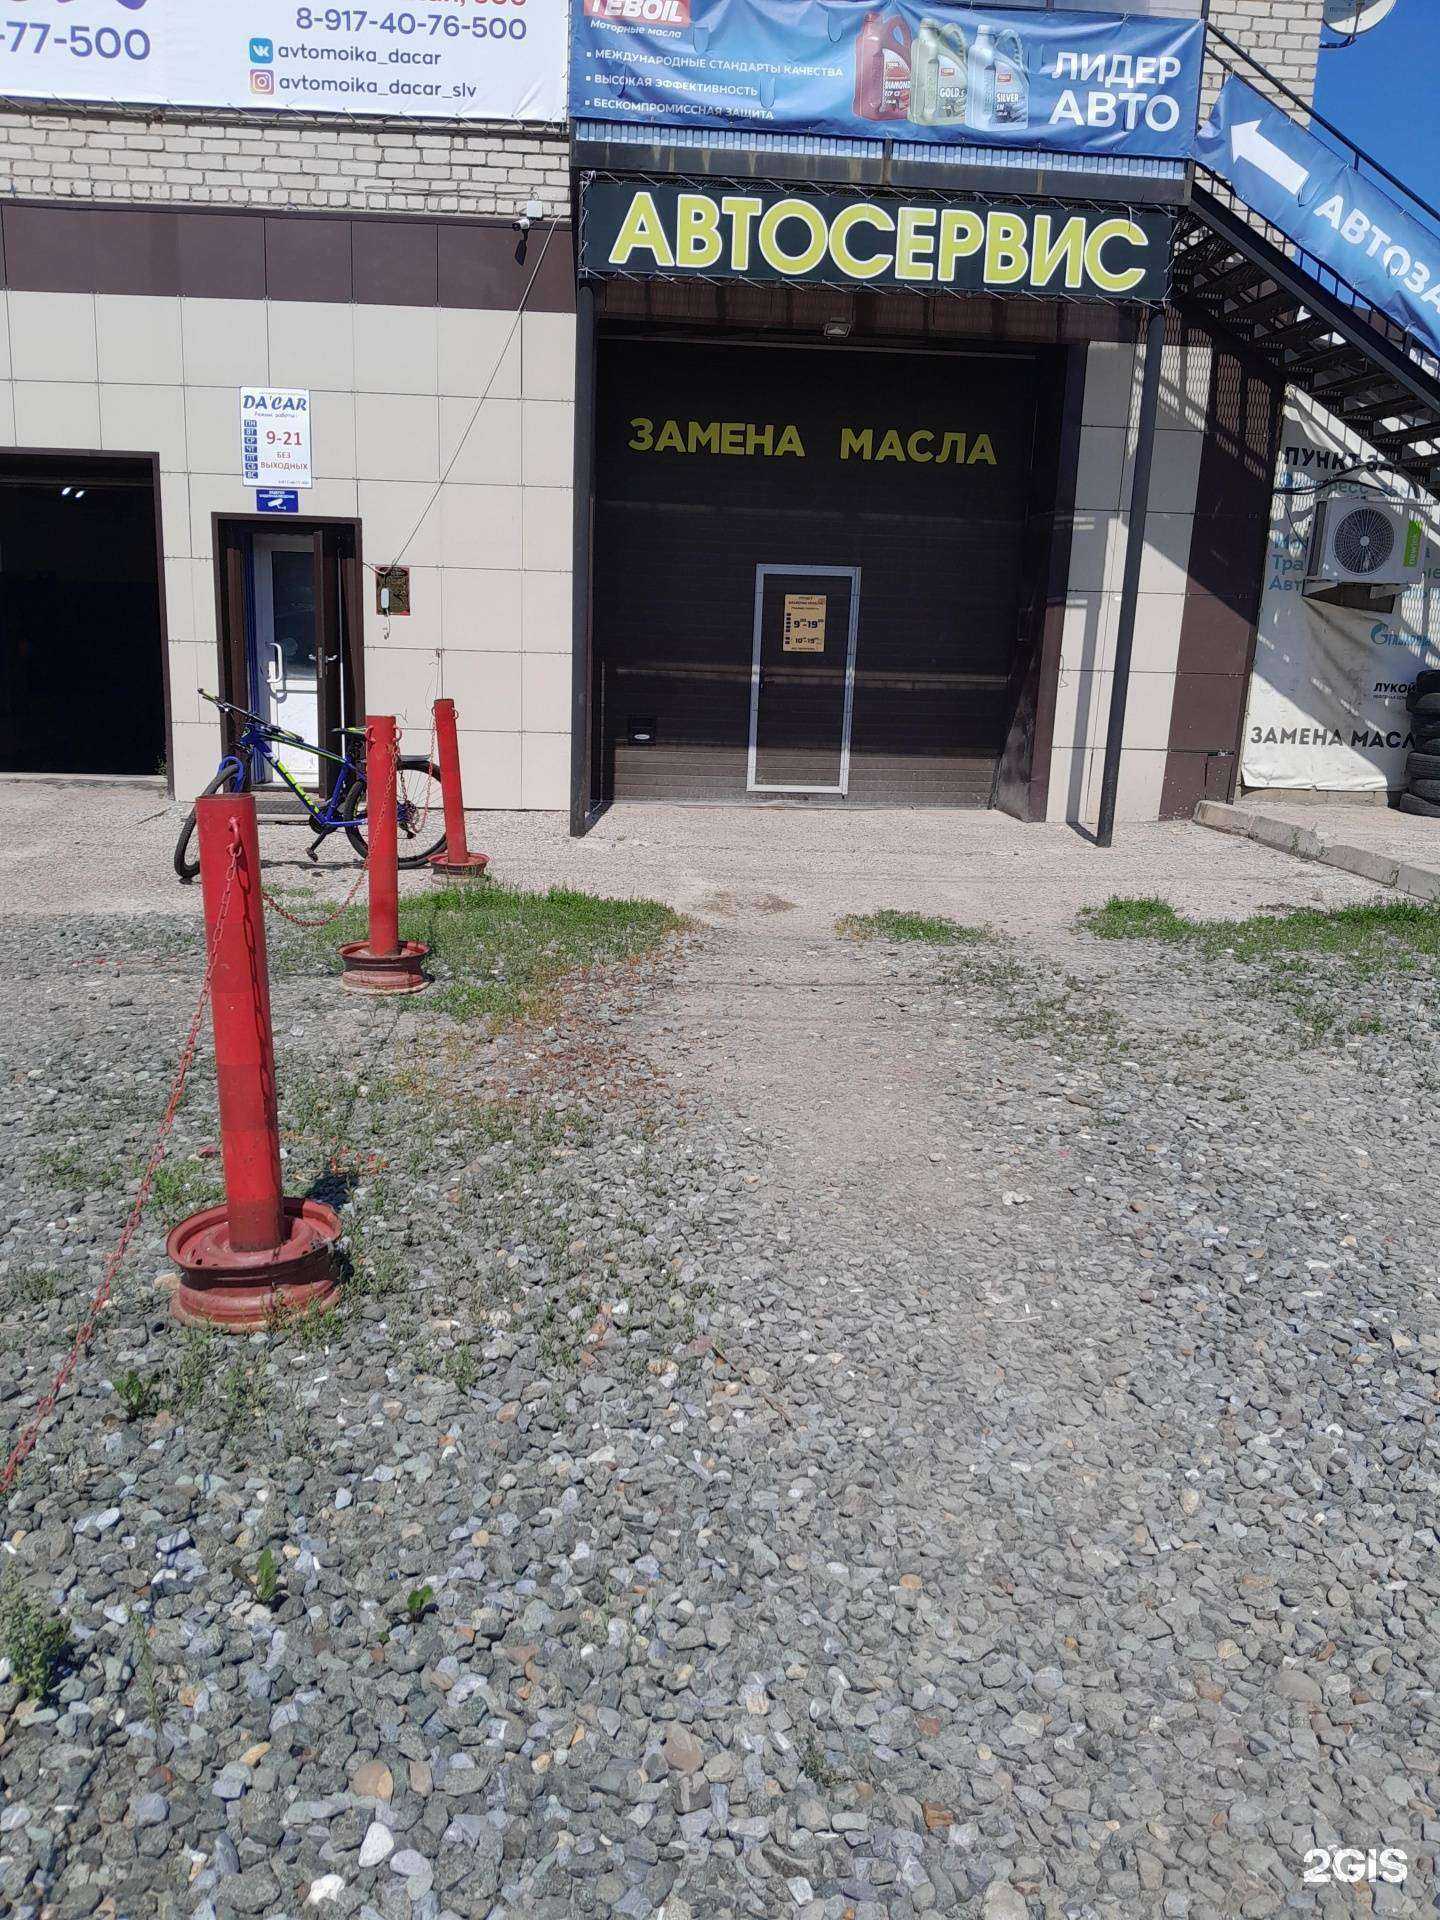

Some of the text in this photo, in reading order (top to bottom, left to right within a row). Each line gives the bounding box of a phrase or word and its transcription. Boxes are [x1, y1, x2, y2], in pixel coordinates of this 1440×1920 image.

[296, 7, 527, 40] 8-917-40-76-500
[591, 20, 682, 38] Моторные масла
[278, 43, 442, 65] avtomoika_dacar
[595, 49, 844, 77] МЕЖДУНАРОДНЫЕ СТАНДАРТЫ КАЧЕСТВА
[1051, 53, 1181, 88] ЛИДЕР
[279, 76, 477, 99] avtomoika_dacar_slv
[594, 74, 758, 96] ВЫСОКАЯ ЭФФЕКТИВНОСТЬ
[940, 87, 959, 98] GOLD
[594, 98, 774, 119] БЕСКОМПРОМИССНАЯ ЗАЩИТА
[996, 92, 1019, 103] SILVER
[1048, 90, 1180, 132] АВТО
[609, 191, 1148, 291] АВТОСЕРВИС
[266, 430, 302, 446] 9-21
[628, 417, 997, 465] ЗАМЕНА МАСЛА
[260, 461, 308, 471] ВЫХОДНЫХ
[276, 451, 291, 459] БЕЗ
[1250, 727, 1343, 746] ЗАМЕНА
